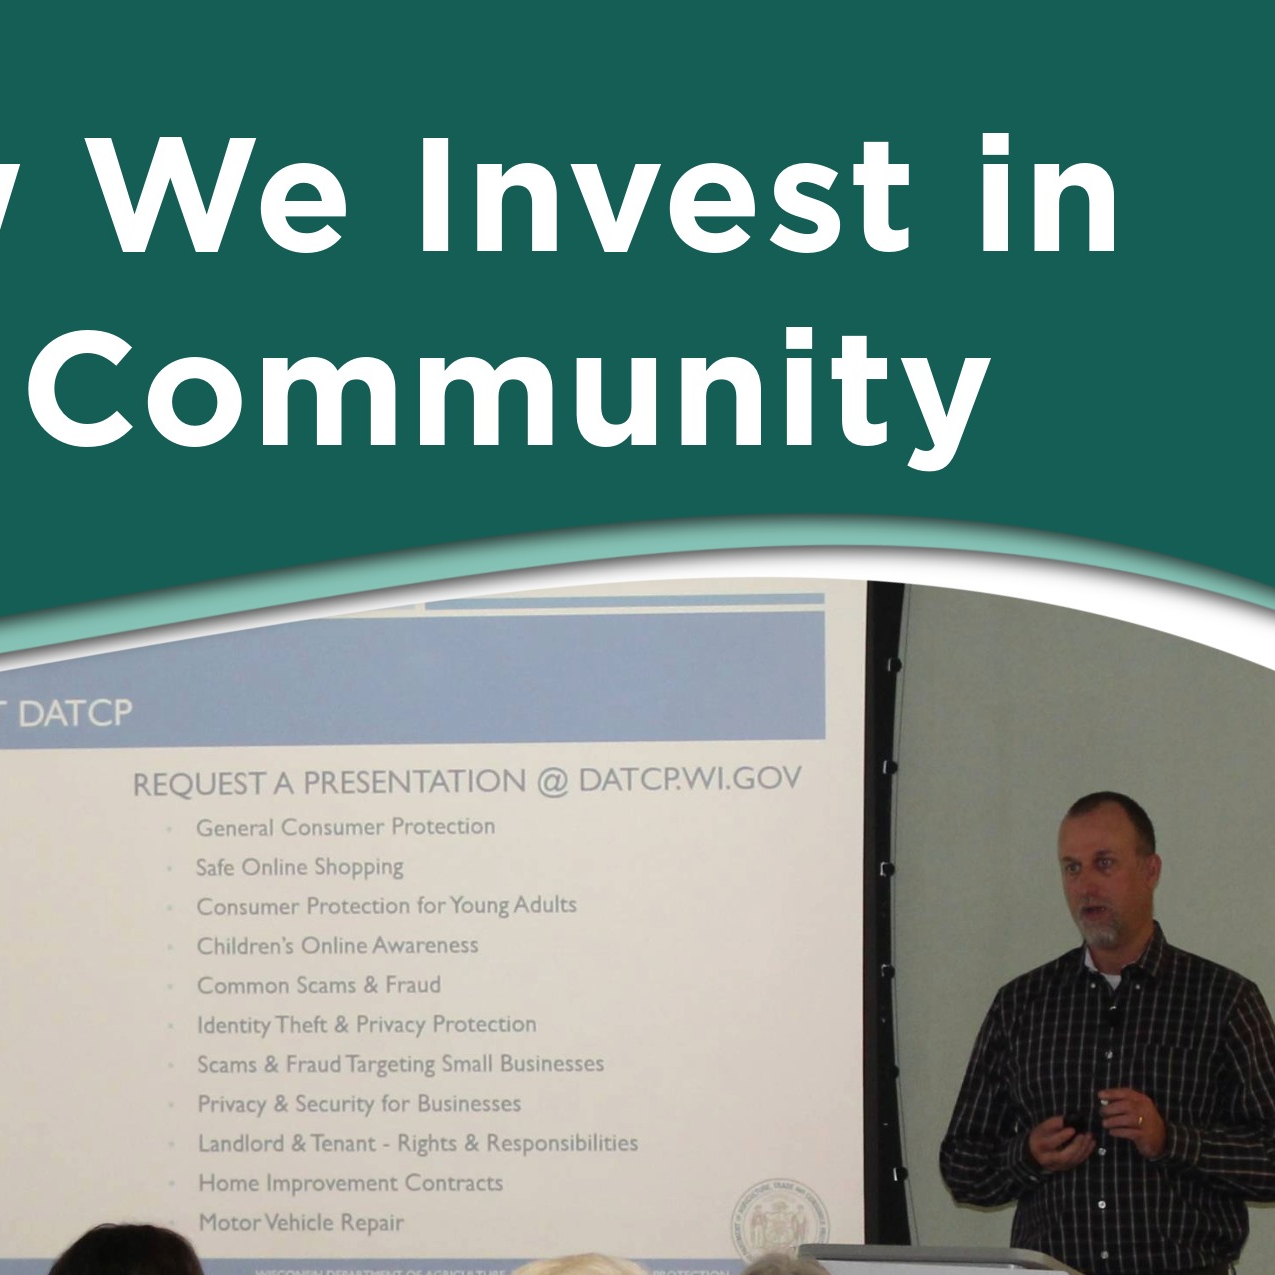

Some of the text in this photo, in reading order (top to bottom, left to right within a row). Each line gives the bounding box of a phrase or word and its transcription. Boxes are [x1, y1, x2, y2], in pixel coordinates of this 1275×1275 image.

[18, 697, 135, 729] DATCP
[134, 765, 803, 801] REQUEST A PRESENTATION @ DATCP.WI.GOV
[196, 816, 496, 838] General Consumer Protection
[196, 856, 404, 881] Safe Online Shopping
[196, 894, 577, 919] Consumer Protection for Young Adults
[196, 935, 479, 956] Children's Online Awareness
[197, 974, 441, 995] Common Scams & Fraud
[198, 1014, 537, 1039] Identity Theft & Privacy Protection
[197, 1053, 605, 1078] Scams & Fraud Targeting Small Businesses
[198, 1093, 522, 1118] Privacy & Security for Businesses
[198, 1133, 285, 1153] Landlord
[291, 1133, 306, 1152] &
[309, 1133, 377, 1153] Tenant
[398, 1133, 457, 1158] Rights
[464, 1133, 479, 1152] &
[487, 1132, 639, 1157] Responsibilities
[199, 1172, 504, 1197] Home Improvement Contracts
[199, 1212, 405, 1237] Motor Vehicle Repair
